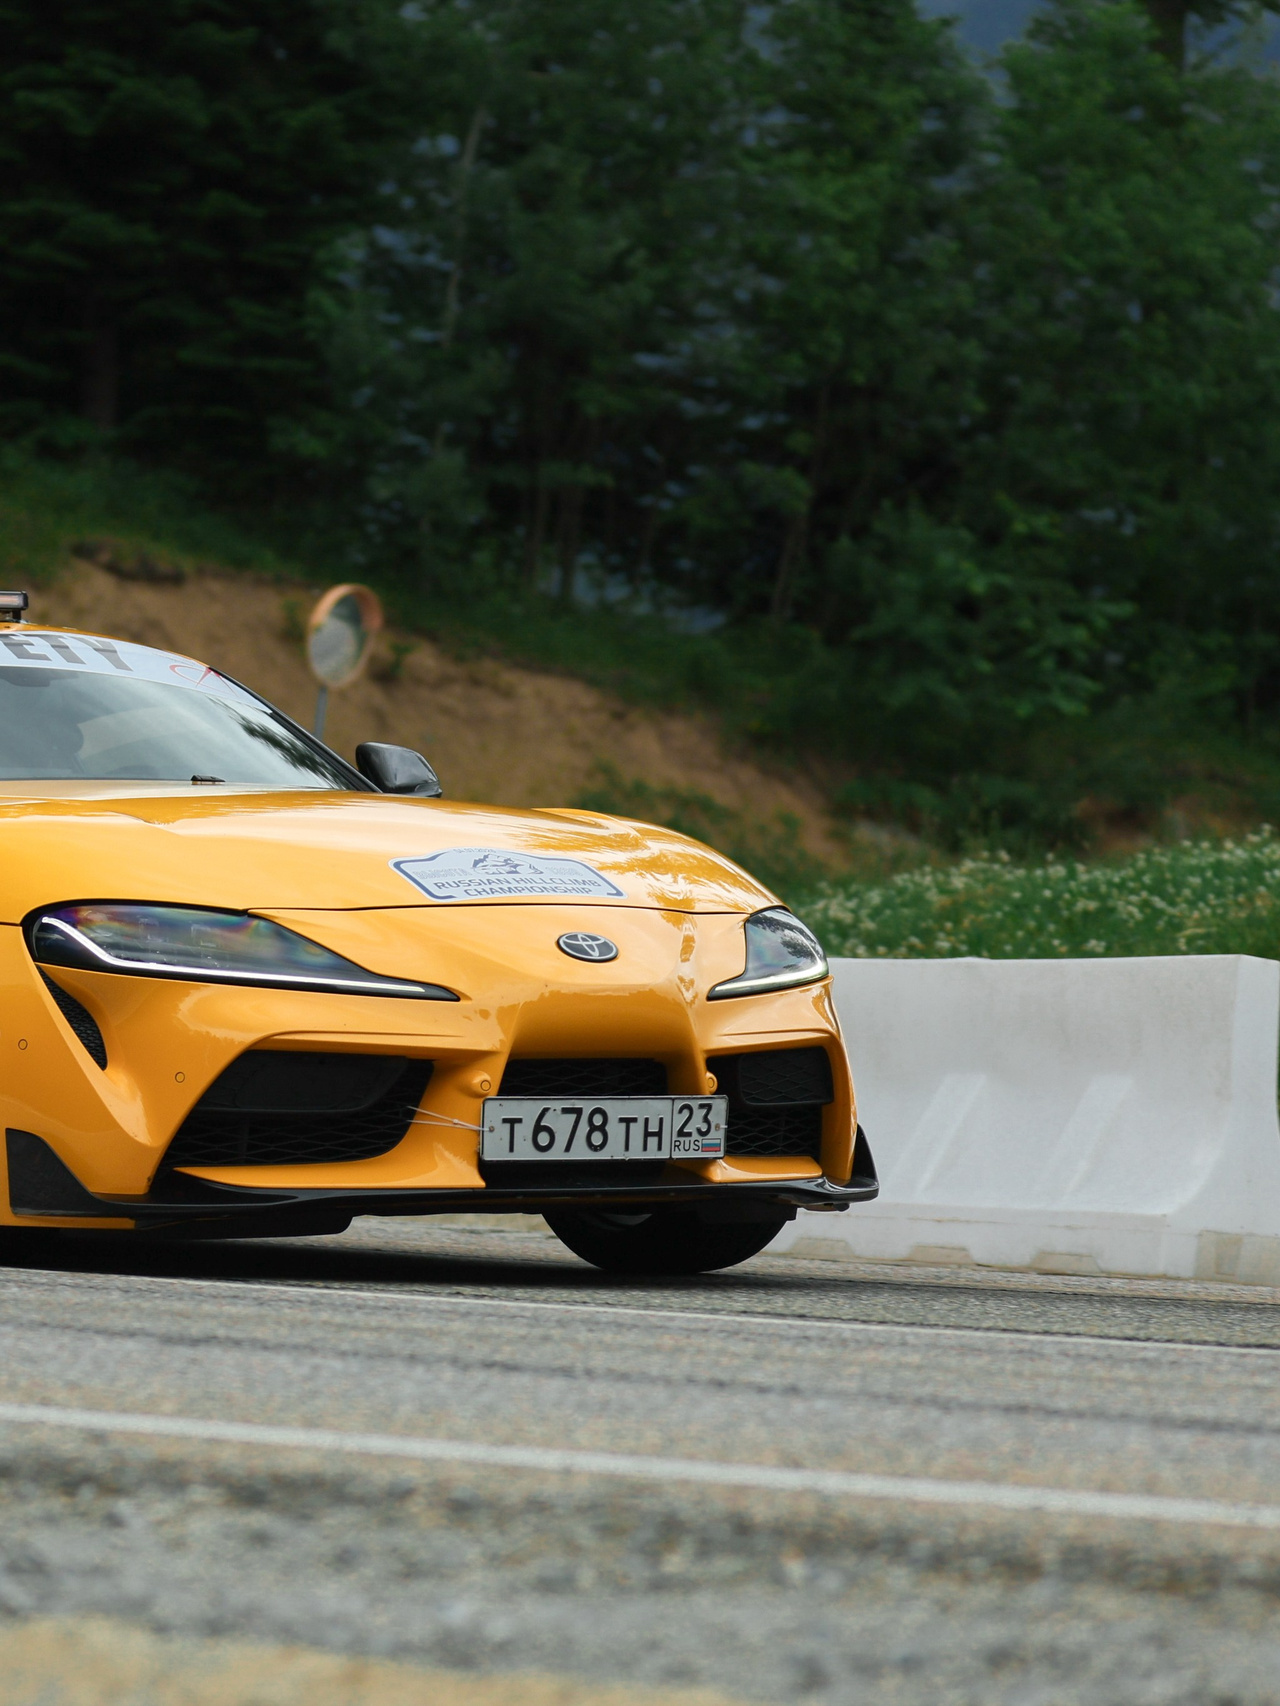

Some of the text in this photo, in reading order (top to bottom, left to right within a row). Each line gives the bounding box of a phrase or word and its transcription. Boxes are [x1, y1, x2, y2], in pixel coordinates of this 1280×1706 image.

[433, 877, 602, 890] RUSSIAN HILLCLIMB
[463, 886, 593, 897] CHAMPIONSHIP
[676, 1102, 713, 1138] 23
[673, 1139, 701, 1152] RUS
